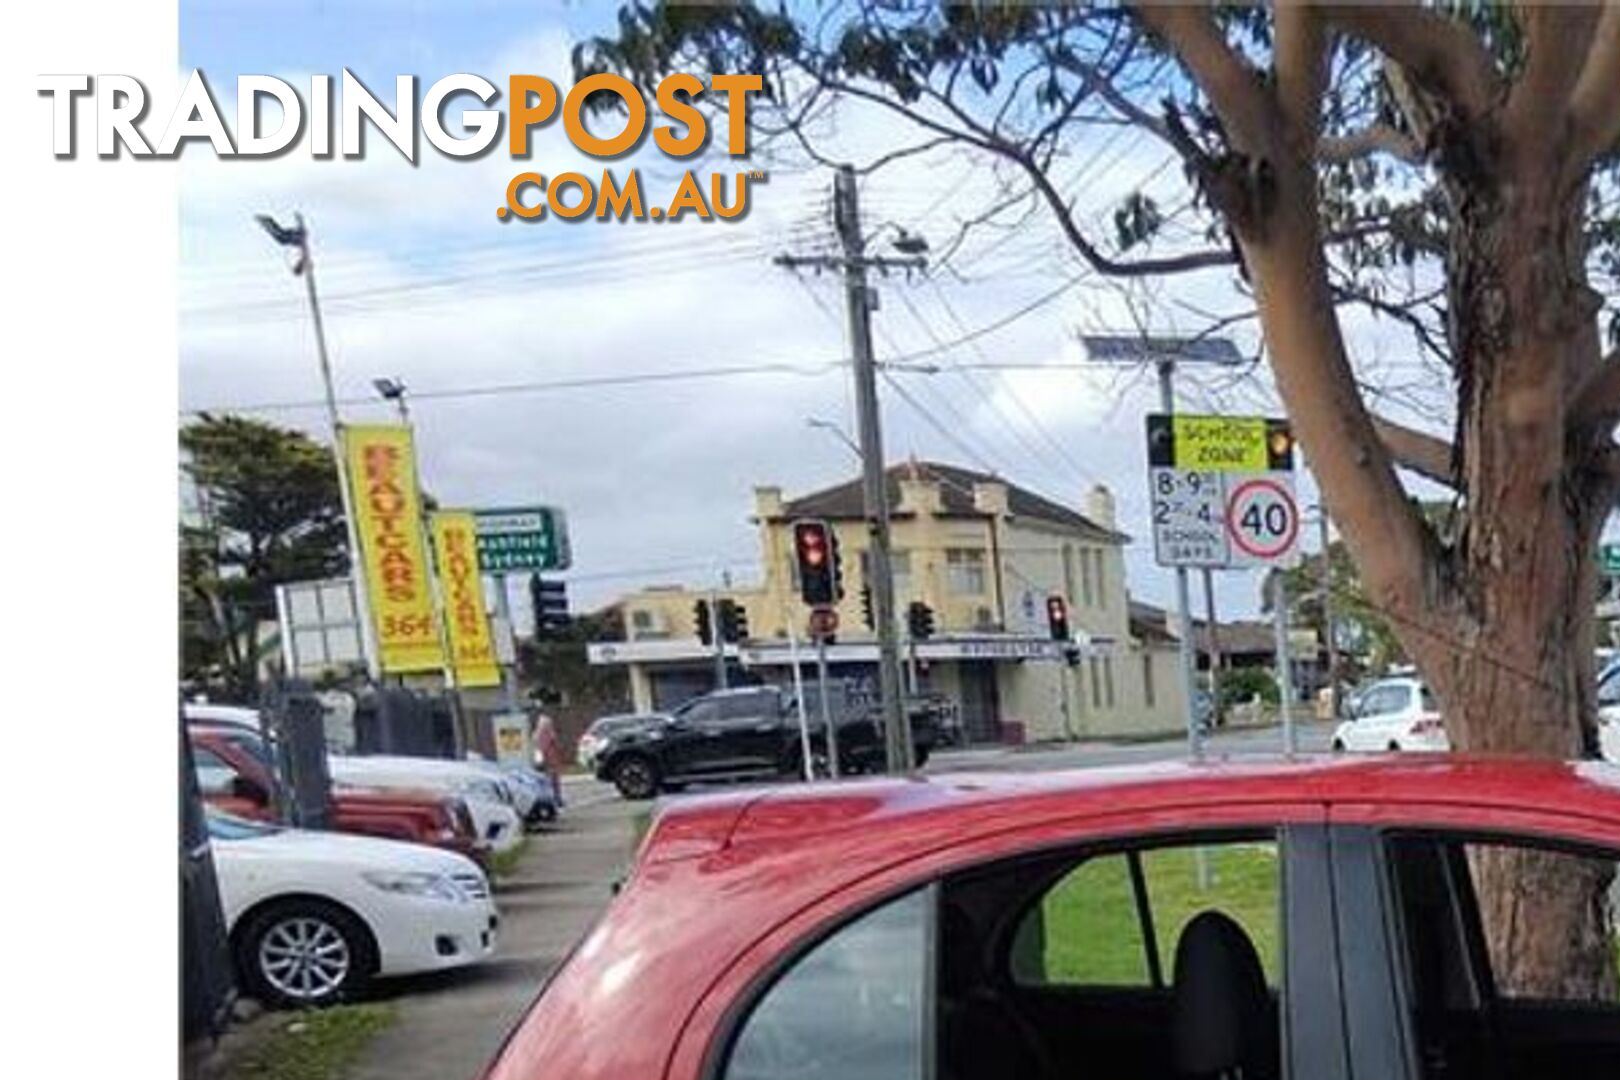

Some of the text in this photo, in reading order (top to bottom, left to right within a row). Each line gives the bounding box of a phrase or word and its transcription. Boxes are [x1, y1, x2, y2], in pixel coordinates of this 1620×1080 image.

[1182, 422, 1262, 446] SCHOOL
[1198, 446, 1246, 463] ZONE
[1240, 502, 1287, 536] 40
